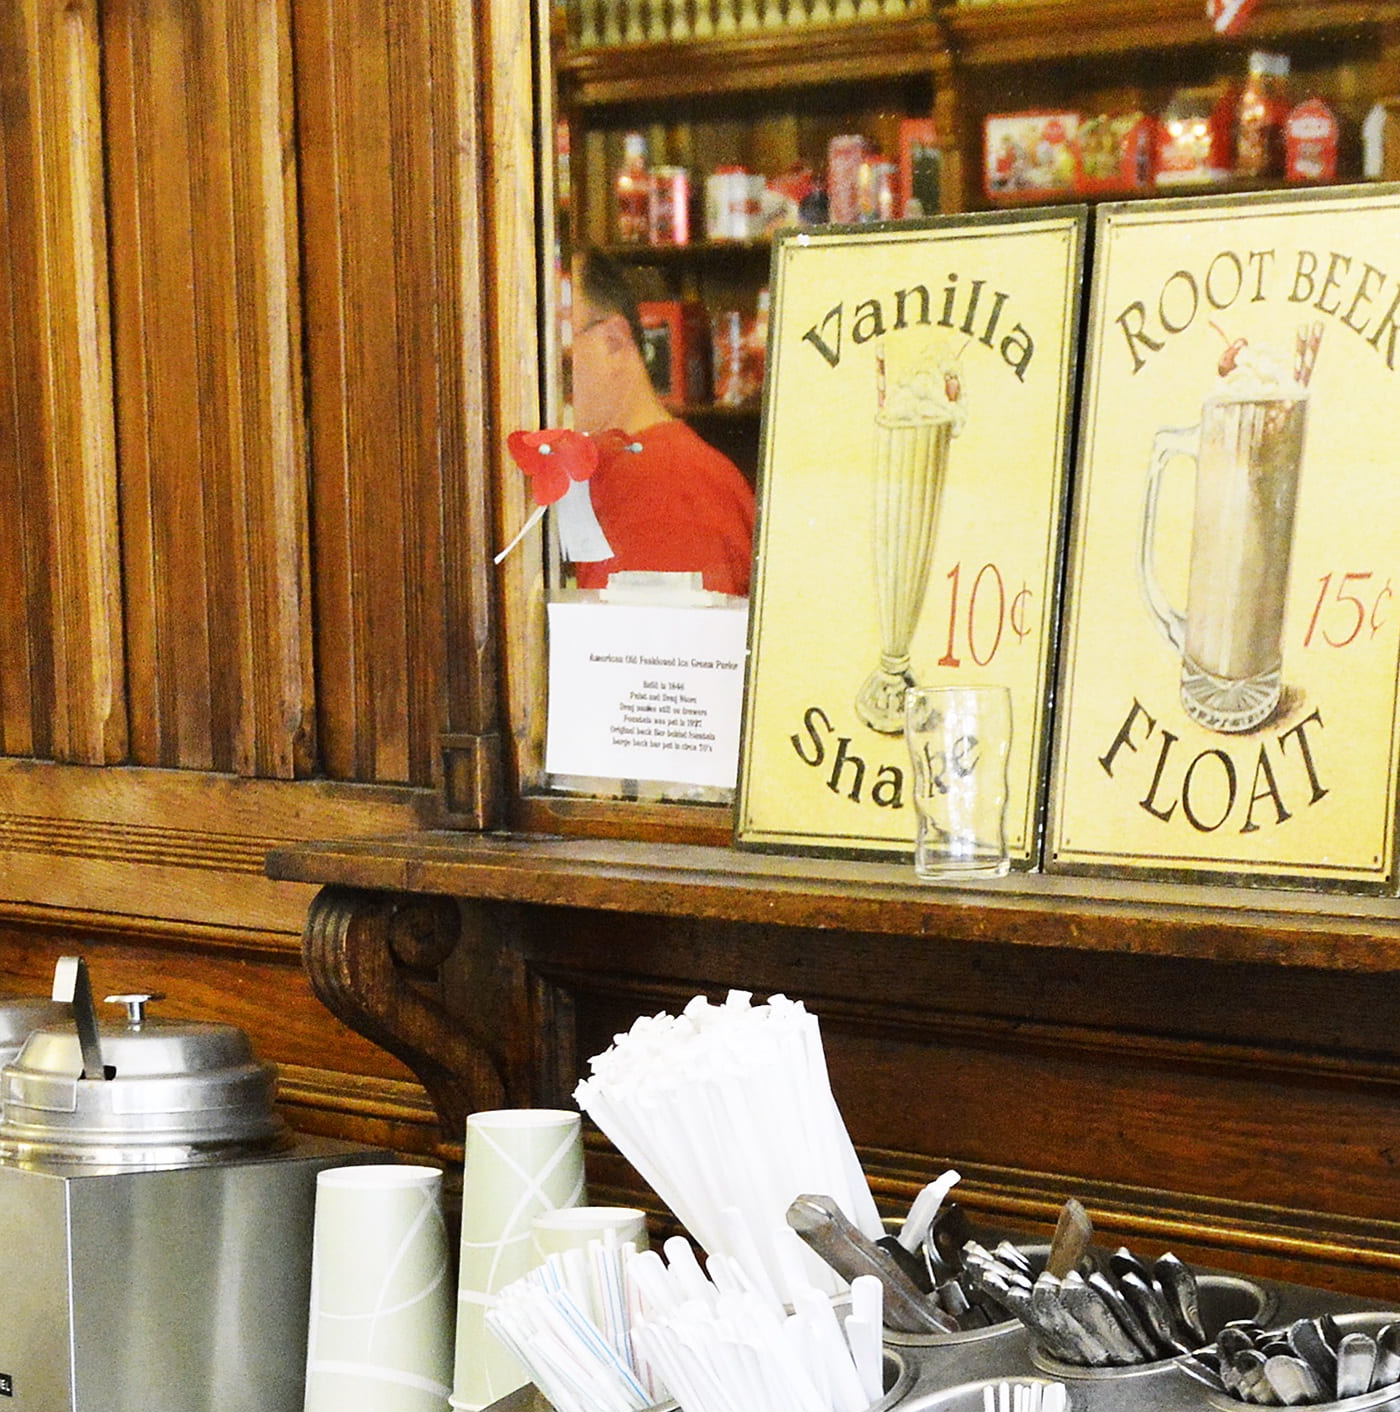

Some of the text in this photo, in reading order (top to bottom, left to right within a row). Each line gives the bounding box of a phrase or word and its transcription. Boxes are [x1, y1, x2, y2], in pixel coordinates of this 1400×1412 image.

[801, 272, 1035, 384] Vanilla
[1115, 249, 1276, 376] ROOT
[937, 561, 1033, 668] 10¢
[1303, 572, 1393, 648] 15¢
[790, 706, 981, 809] Shake
[1098, 696, 1330, 835] FLOAT
